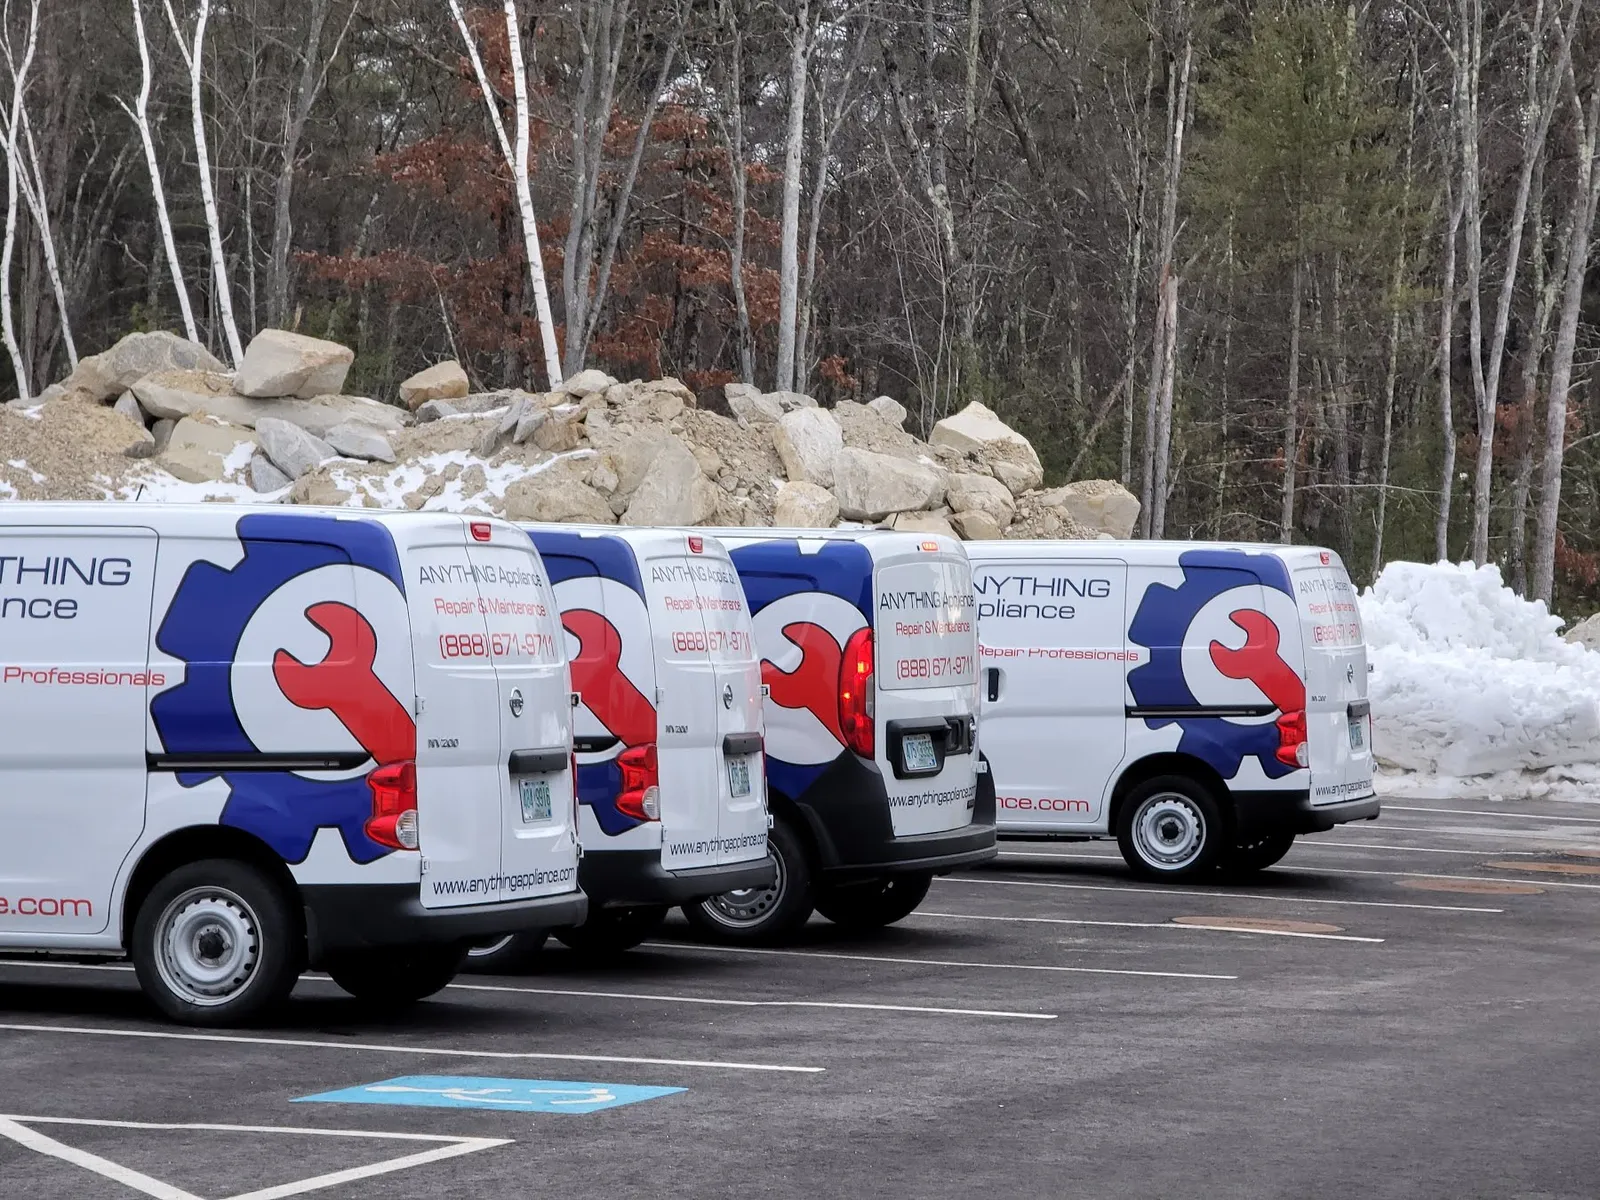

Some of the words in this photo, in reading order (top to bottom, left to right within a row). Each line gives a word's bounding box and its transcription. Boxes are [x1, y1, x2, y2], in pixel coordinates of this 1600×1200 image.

[0, 556, 131, 586] THING
[419, 565, 496, 584] ANYTHING
[500, 567, 543, 587] Appliance
[2, 598, 78, 619] nce
[434, 598, 476, 617] Repair
[478, 597, 489, 614] &
[489, 598, 546, 617] Maintenance
[664, 596, 694, 613] Repair
[880, 592, 941, 610] ANYTHING
[977, 598, 1076, 621] pliance
[896, 621, 923, 639] Repair
[925, 620, 931, 634] &
[439, 634, 489, 659] (888)
[492, 633, 555, 657] 671-9711
[672, 632, 709, 653] (888)
[978, 644, 1024, 658] Repair
[1028, 648, 1138, 661] Professionals
[4, 667, 165, 686] Professionals
[896, 658, 930, 680] (888)
[933, 656, 974, 676] 671-9711
[670, 833, 767, 855] www.anythingappliance.com
[432, 867, 575, 894] www.anythingappliance.com
